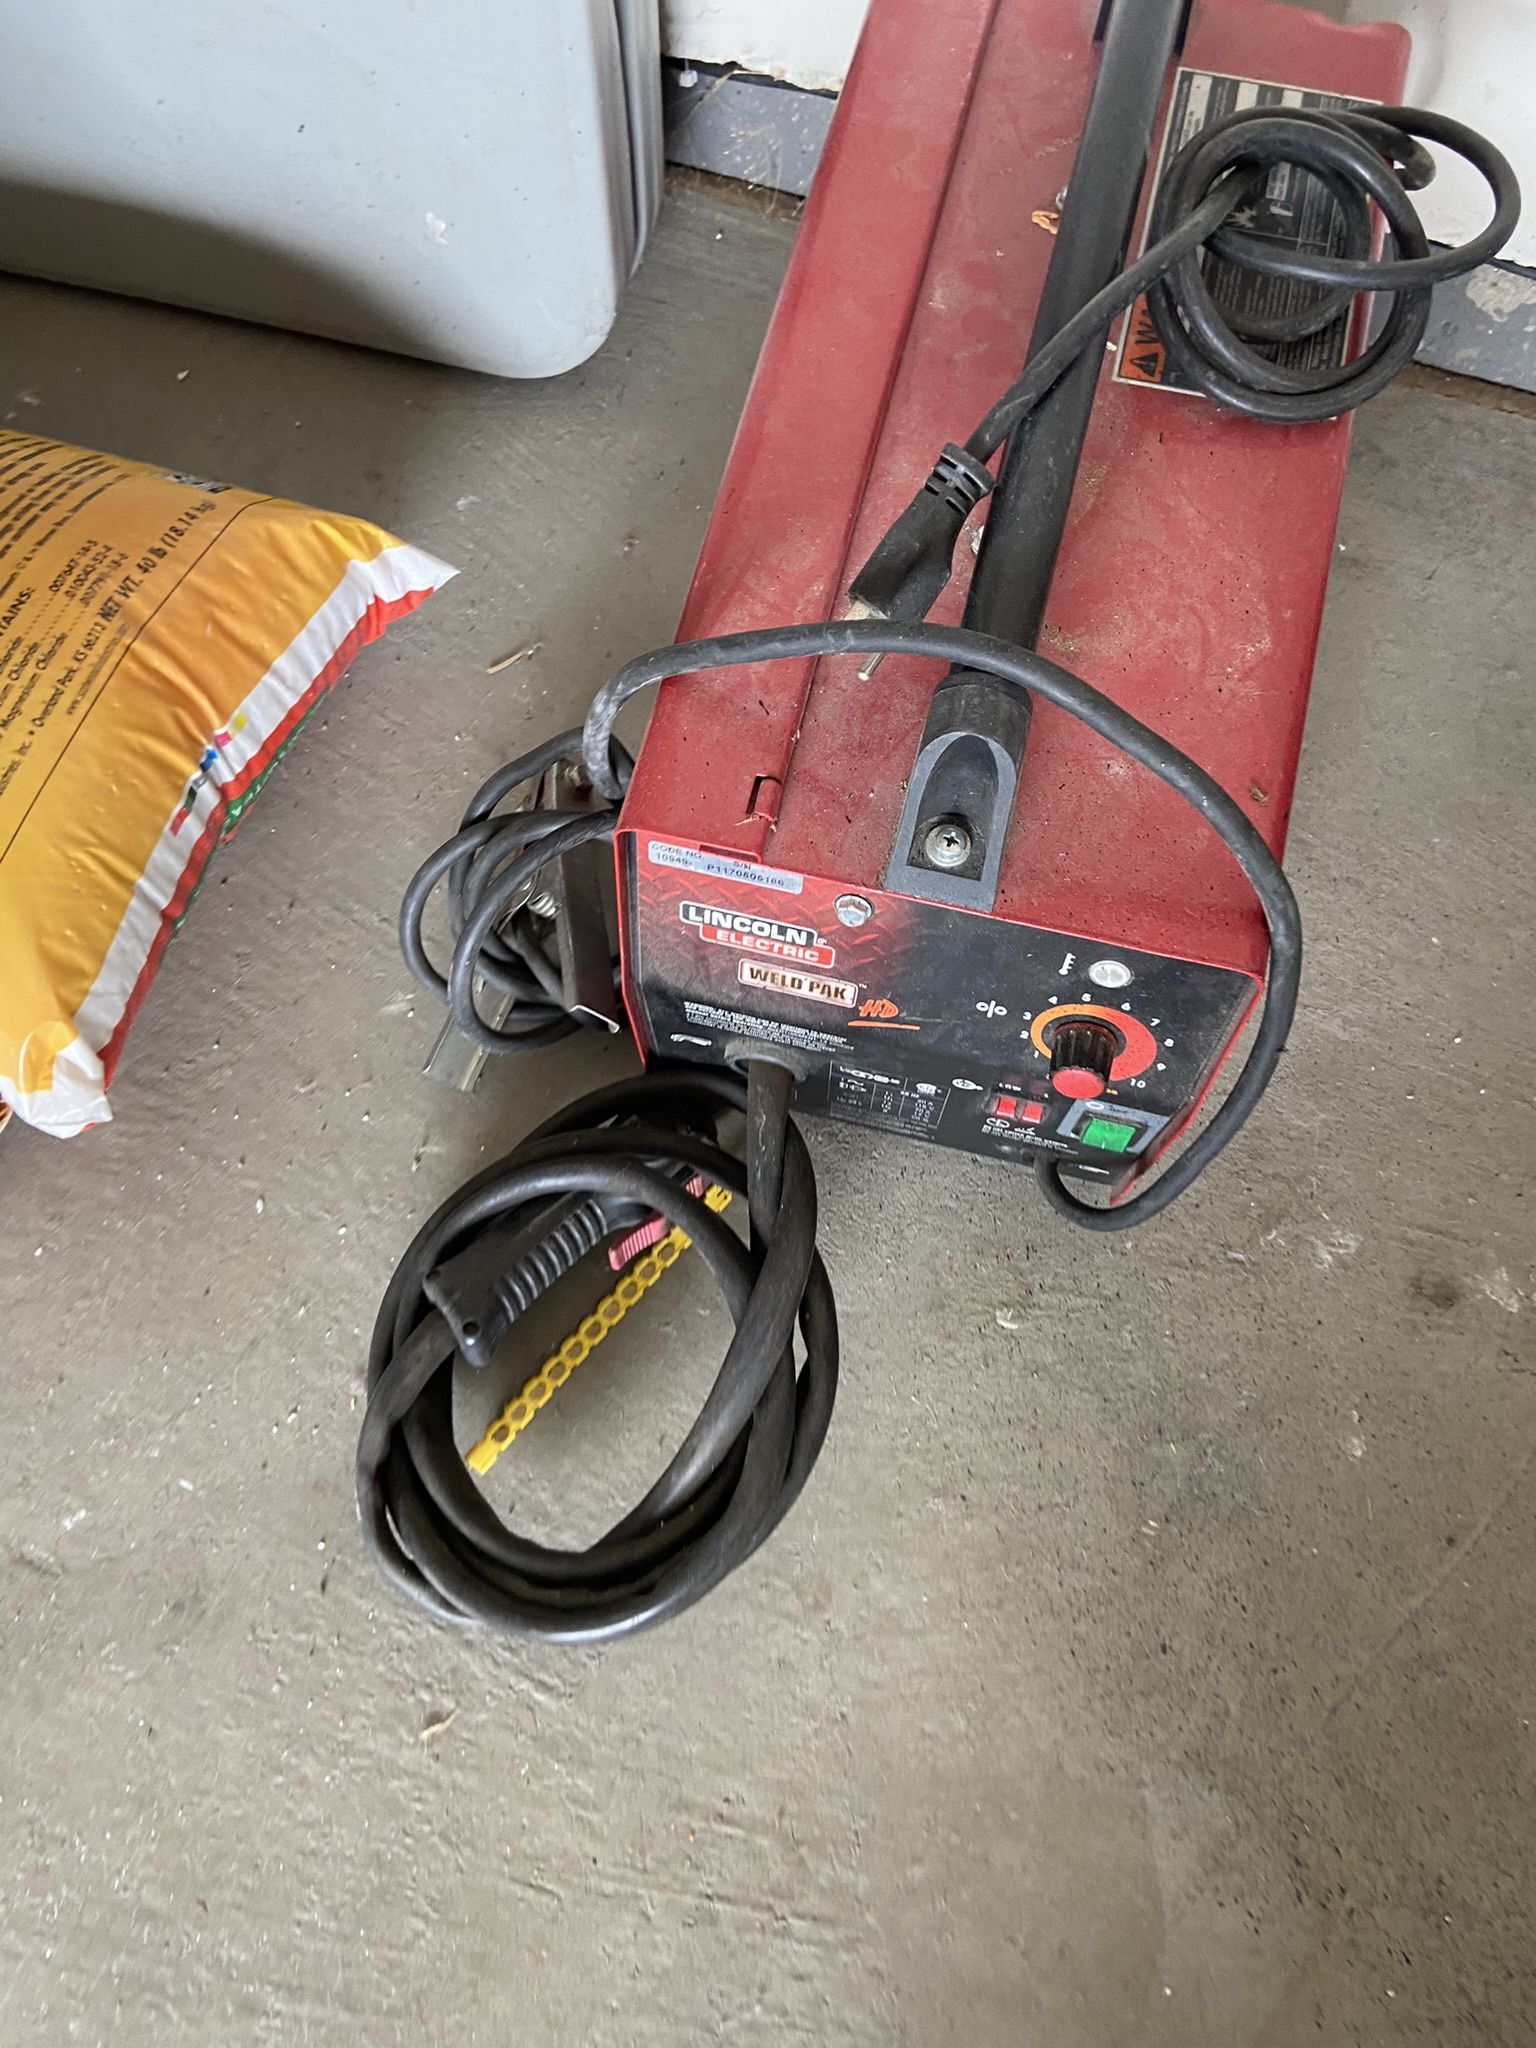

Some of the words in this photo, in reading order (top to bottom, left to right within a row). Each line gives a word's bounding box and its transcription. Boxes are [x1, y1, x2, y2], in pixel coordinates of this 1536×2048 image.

[96, 595, 122, 622] NET
[114, 576, 143, 599] WT.
[135, 554, 157, 575] 40
[688, 906, 808, 946] LINCOLN
[716, 931, 820, 962] ELECTRIC
[748, 966, 802, 990] WELD
[807, 981, 847, 1000] PAK
[1048, 995, 1058, 1004] 4
[1081, 992, 1092, 1002] 5
[1120, 1001, 1131, 1011] 6
[1022, 1011, 1032, 1021] 3
[1150, 1017, 1160, 1027] 7
[1019, 1030, 1029, 1040] 2
[1164, 1037, 1175, 1048] 8
[1156, 1061, 1167, 1071] 9
[1130, 1077, 1147, 1089] 10
